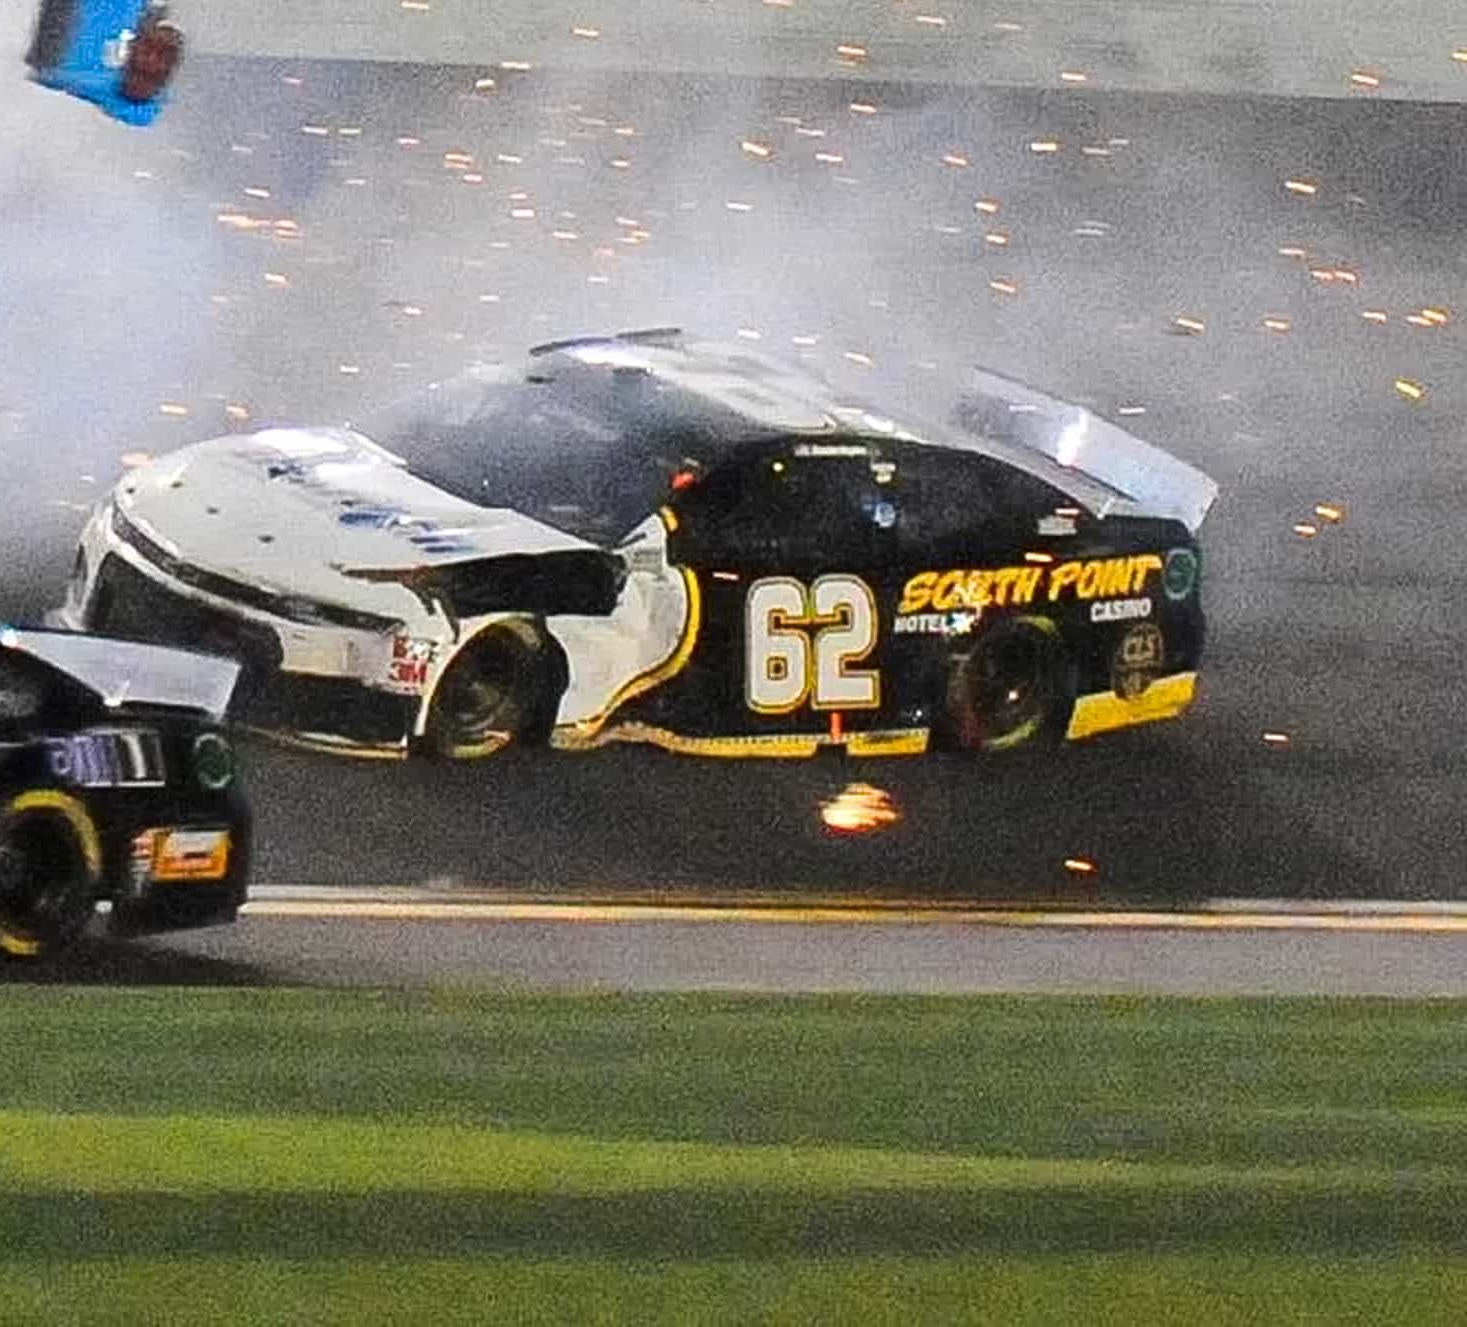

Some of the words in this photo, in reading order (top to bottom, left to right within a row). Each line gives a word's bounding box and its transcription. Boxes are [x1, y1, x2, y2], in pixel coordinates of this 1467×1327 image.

[897, 566, 1042, 615] SOUTH
[1047, 552, 1162, 602] POINT
[893, 612, 949, 634] HOTEL
[1089, 597, 1153, 622] CASINO
[744, 574, 880, 715] 62
